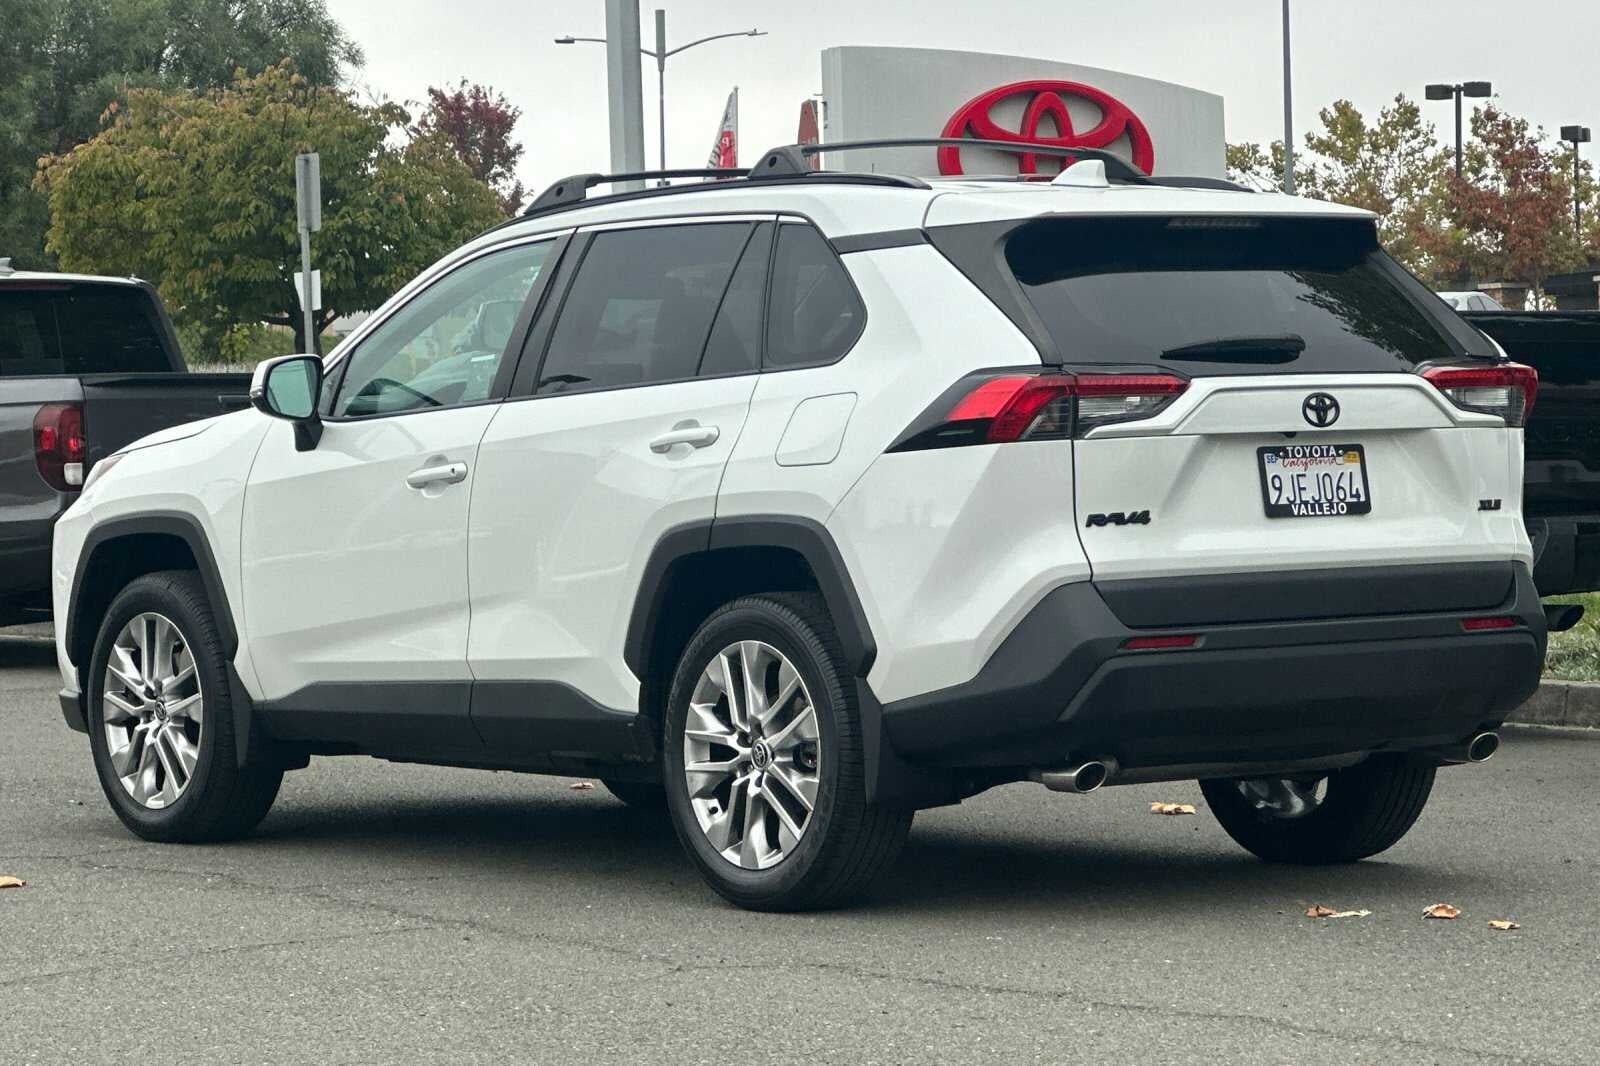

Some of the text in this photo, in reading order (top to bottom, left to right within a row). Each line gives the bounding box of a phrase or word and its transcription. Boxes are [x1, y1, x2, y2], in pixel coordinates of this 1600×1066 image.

[1286, 446, 1337, 458] TOYOTA
[1281, 457, 1341, 470] California
[1271, 471, 1362, 504] 9JEJ064
[1291, 502, 1347, 516] VALLEJO
[1085, 510, 1152, 527] RAV4
